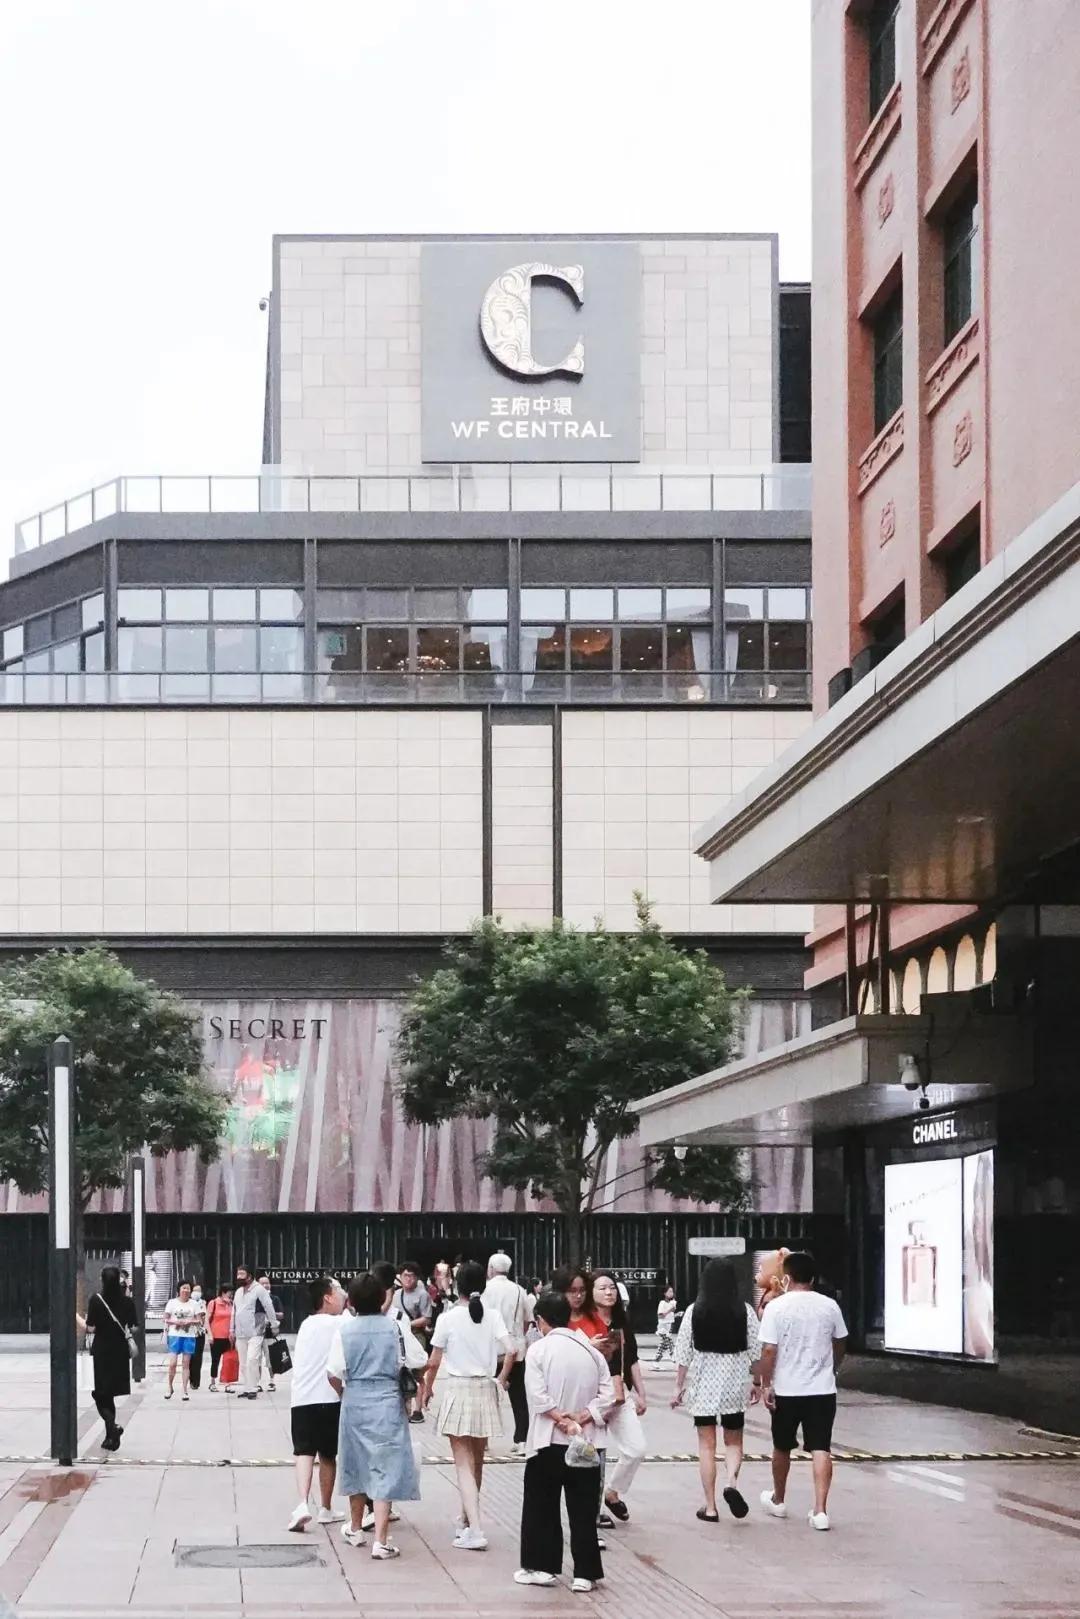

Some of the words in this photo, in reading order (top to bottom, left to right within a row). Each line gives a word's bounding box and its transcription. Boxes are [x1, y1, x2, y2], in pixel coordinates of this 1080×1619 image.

[480, 262, 585, 376] C
[490, 396, 573, 416] 王府中環
[451, 421, 490, 438] WF
[498, 420, 613, 438] CENTRAL
[209, 1016, 328, 1040] SECRET
[912, 1119, 958, 1144] CHANEL
[264, 1271, 320, 1279] VICTORIA'S
